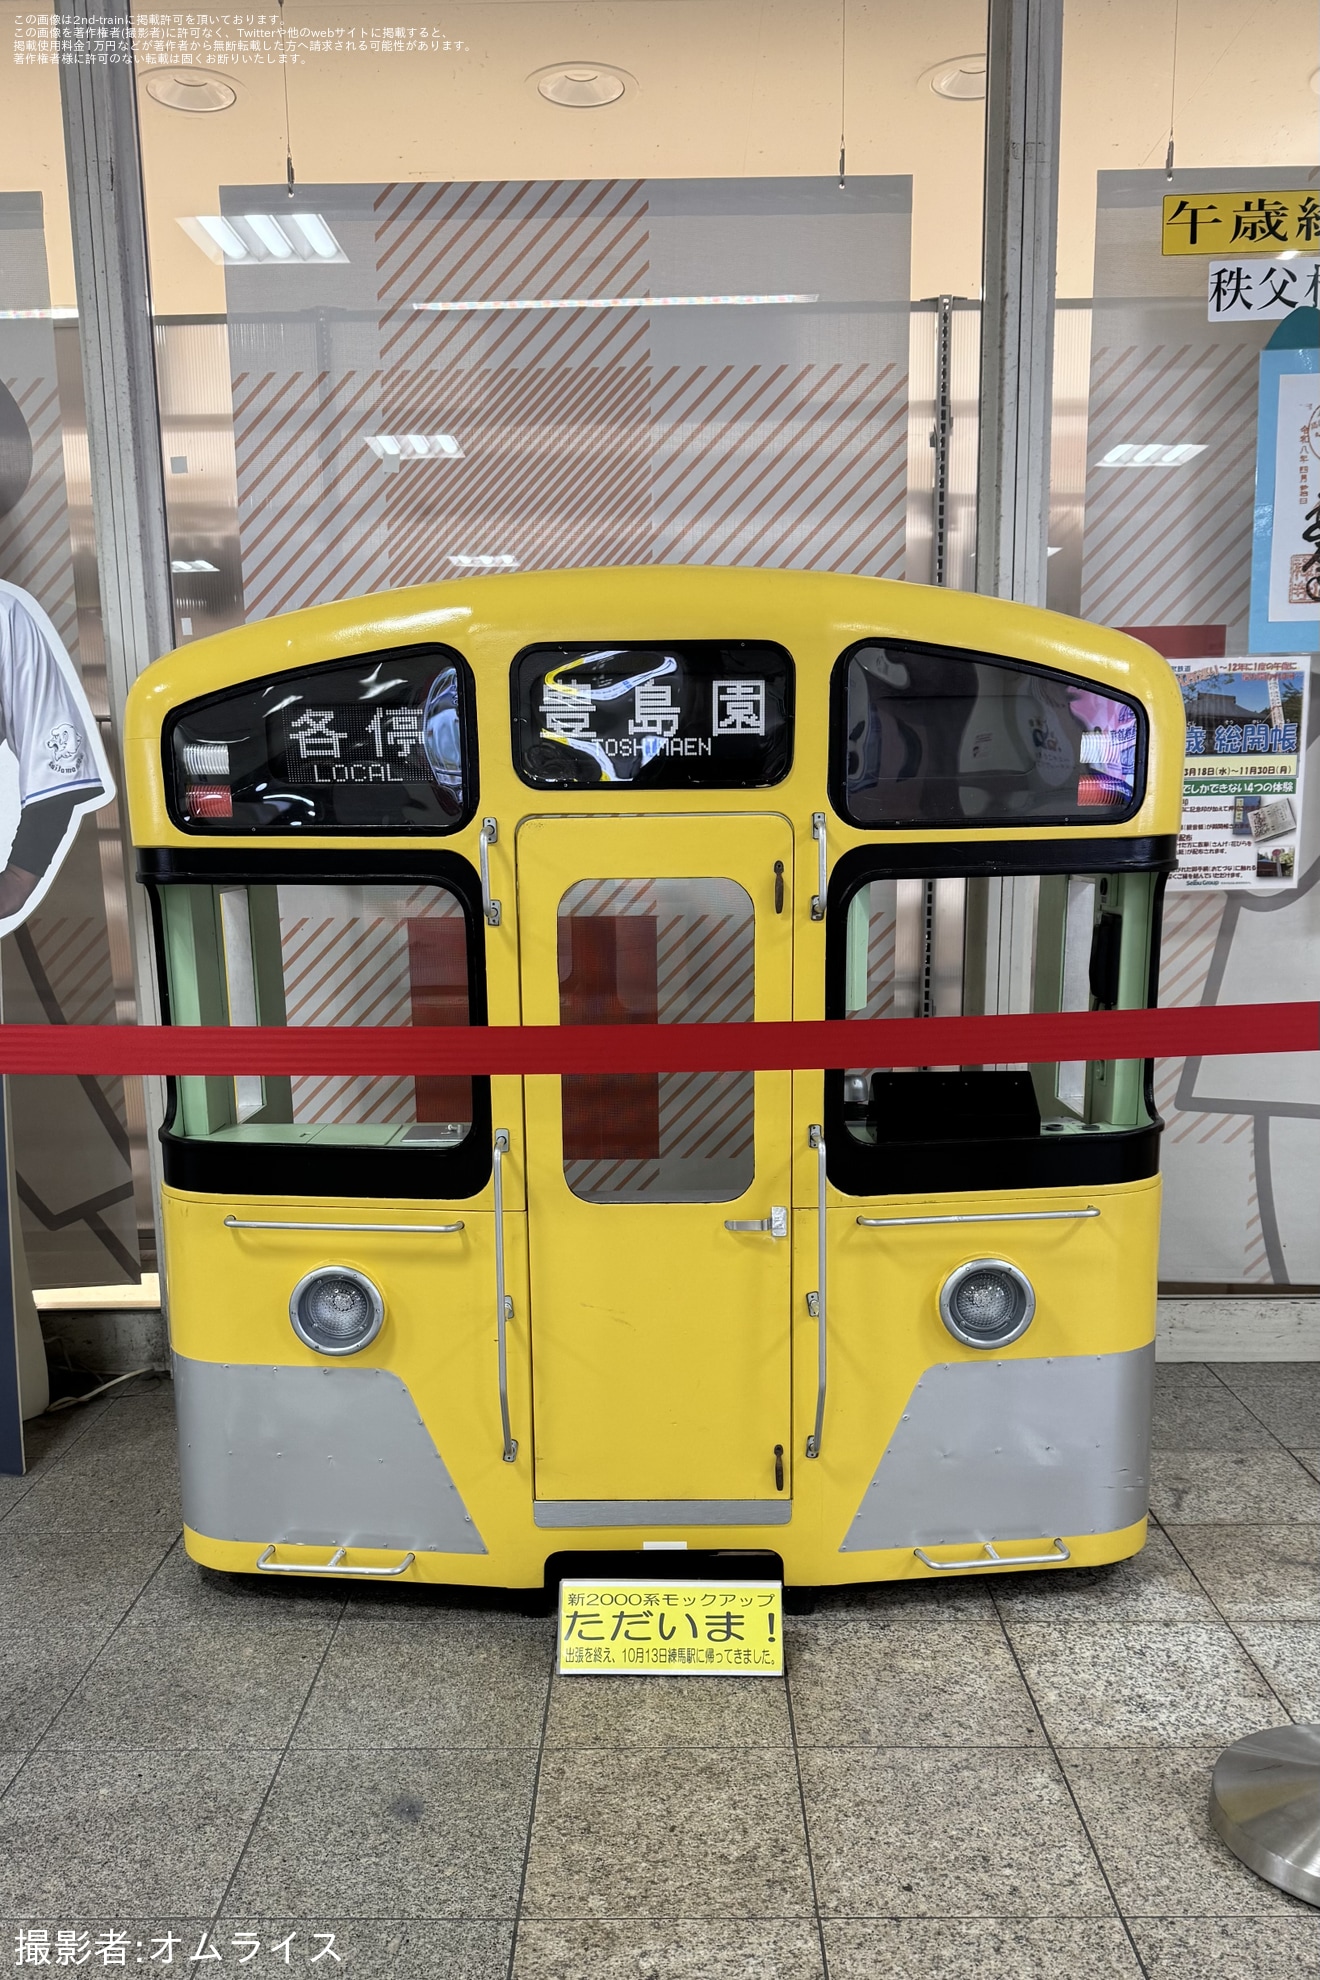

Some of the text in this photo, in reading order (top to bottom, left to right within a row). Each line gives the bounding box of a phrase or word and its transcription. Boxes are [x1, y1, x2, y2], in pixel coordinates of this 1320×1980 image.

[539, 679, 765, 737] 豊島園
[289, 707, 425, 757] 各停
[1214, 723, 1298, 753] 総開帳
[591, 738, 711, 756] TOSHIMAEN
[314, 764, 403, 782] LOCAL
[567, 1593, 775, 1607] 新2000系モックアップ
[565, 1647, 775, 1665] 出張を終え、10月13日練馬駅に帰ってきました。
